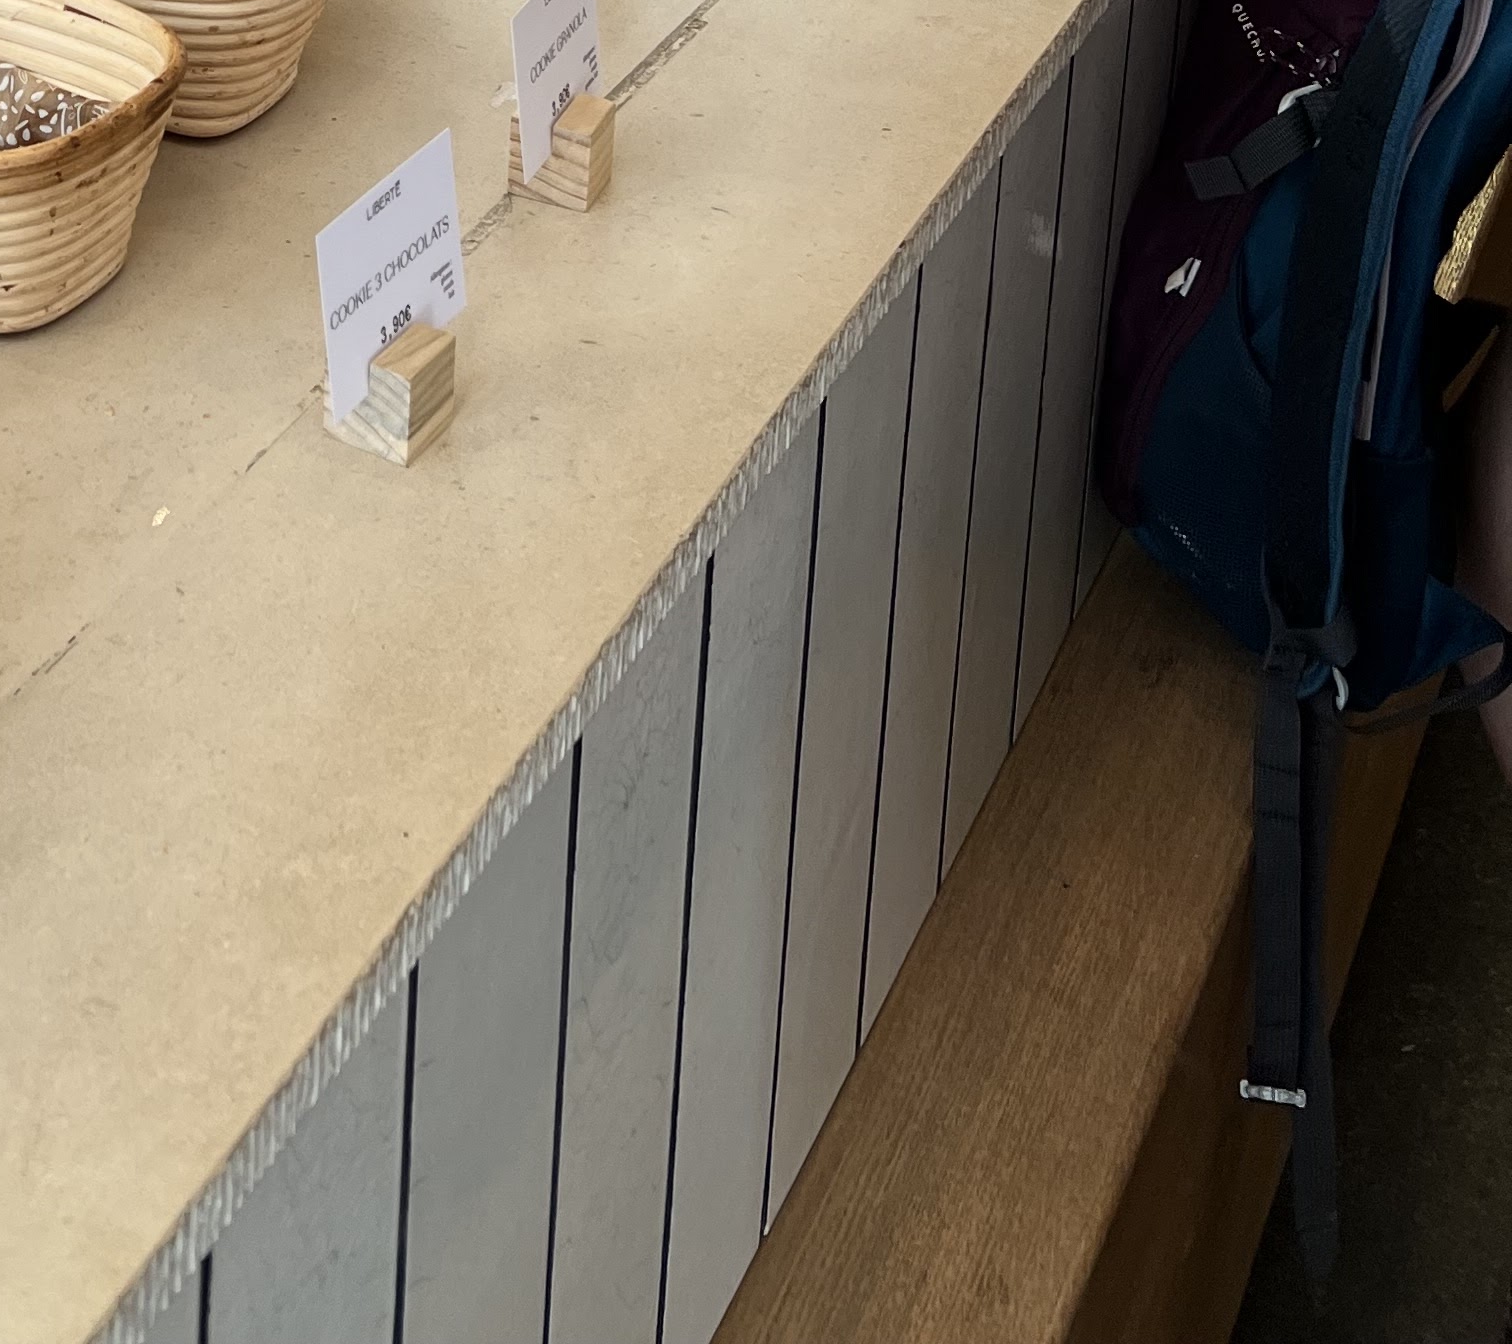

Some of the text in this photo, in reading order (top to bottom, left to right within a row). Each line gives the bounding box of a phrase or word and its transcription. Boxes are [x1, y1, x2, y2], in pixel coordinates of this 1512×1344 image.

[530, 5, 588, 84] COOKIE GRANOLA
[1232, 3, 1266, 63] QUECHU
[330, 279, 373, 330] COOKIE
[374, 271, 383, 292] 3
[383, 214, 450, 283] CHOCOLATS
